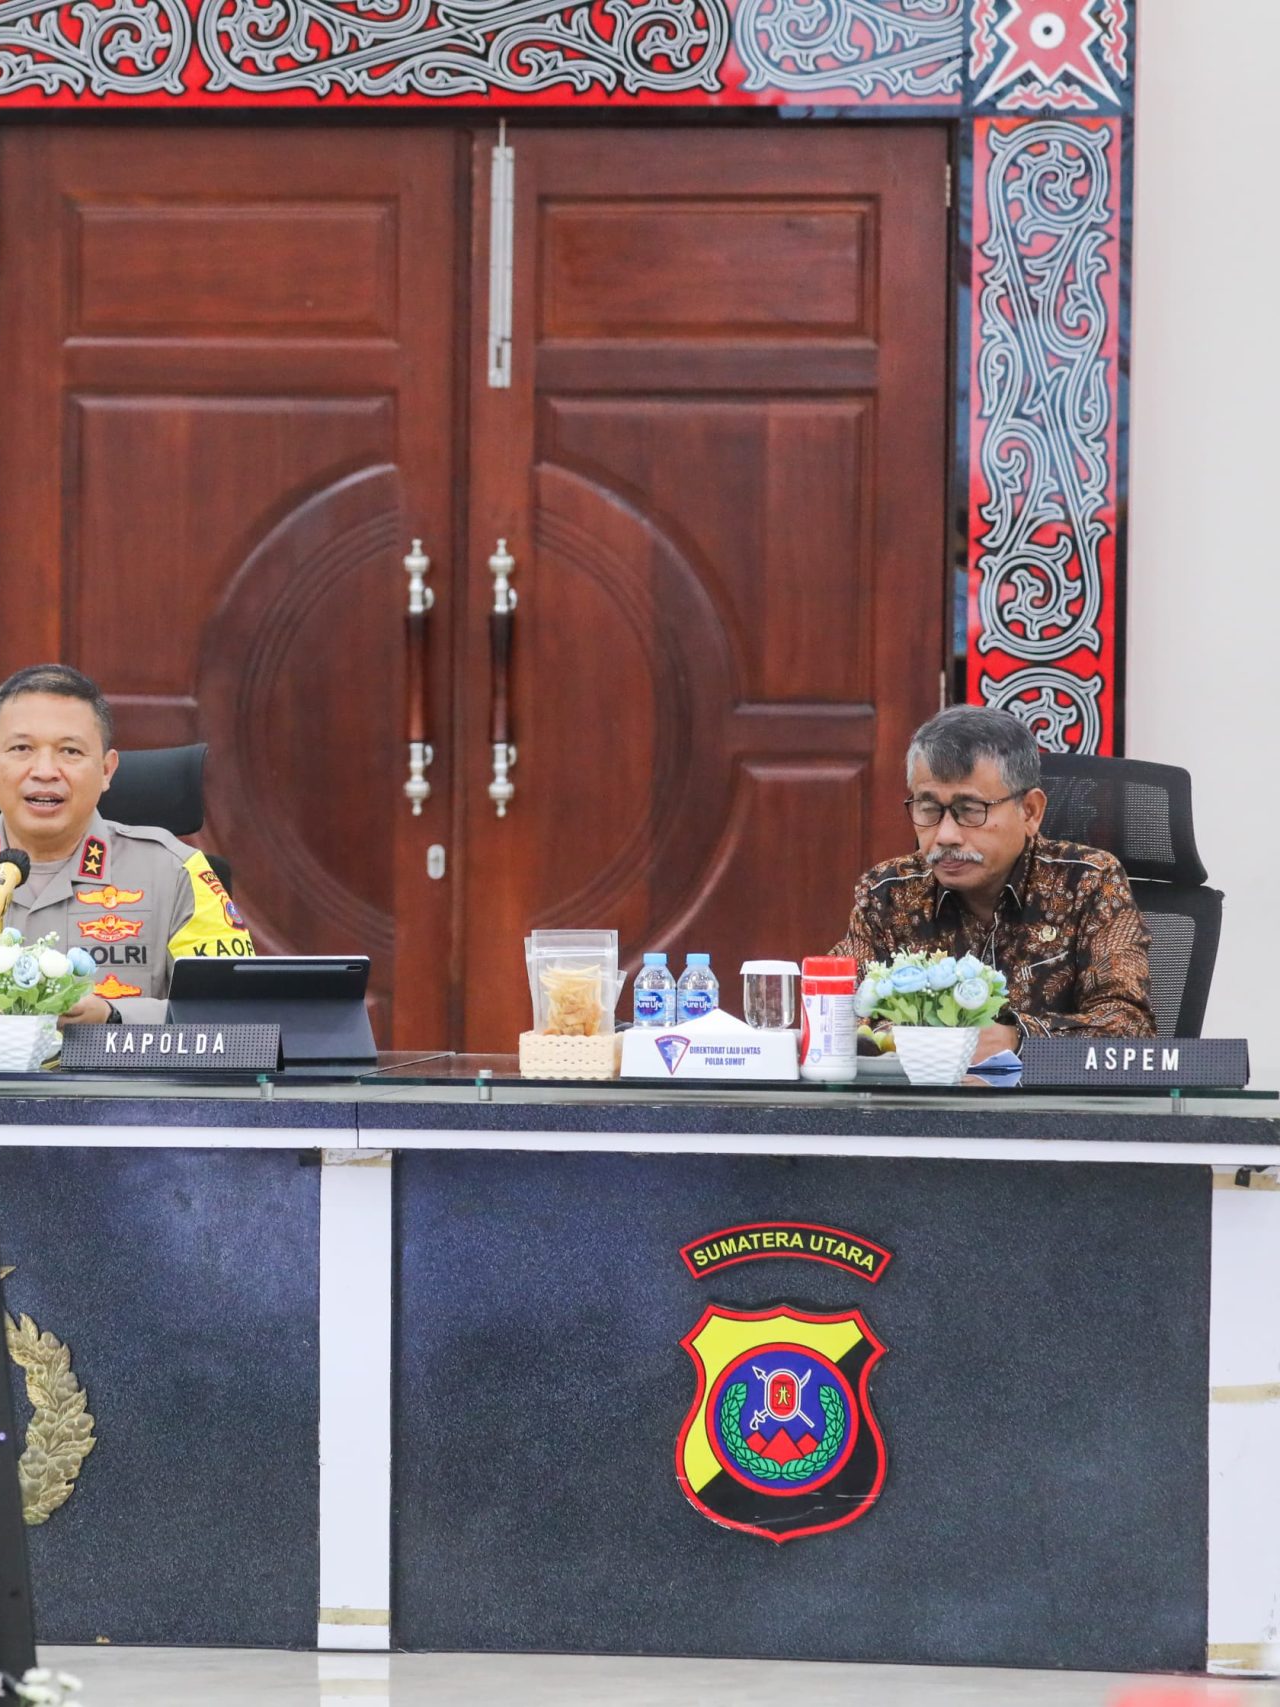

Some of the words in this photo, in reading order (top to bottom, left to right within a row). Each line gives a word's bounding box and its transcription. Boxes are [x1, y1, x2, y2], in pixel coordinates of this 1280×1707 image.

[80, 945, 147, 965] OLRI
[636, 1000, 649, 1009] Pure
[650, 1000, 663, 1010] Life
[682, 1001, 699, 1009] Pure
[699, 1000, 712, 1011] Life
[105, 1032, 225, 1054] KAPOLDA
[689, 1046, 725, 1054] DIREKTORAT
[726, 1046, 740, 1054] LALU
[741, 1046, 761, 1054] LINTAS
[705, 1057, 724, 1066] POLDA
[724, 1057, 745, 1066] SUMUT
[1084, 1047, 1179, 1071] ASPEM
[693, 1232, 804, 1266] SUMATERA
[809, 1235, 876, 1271] UTARA
